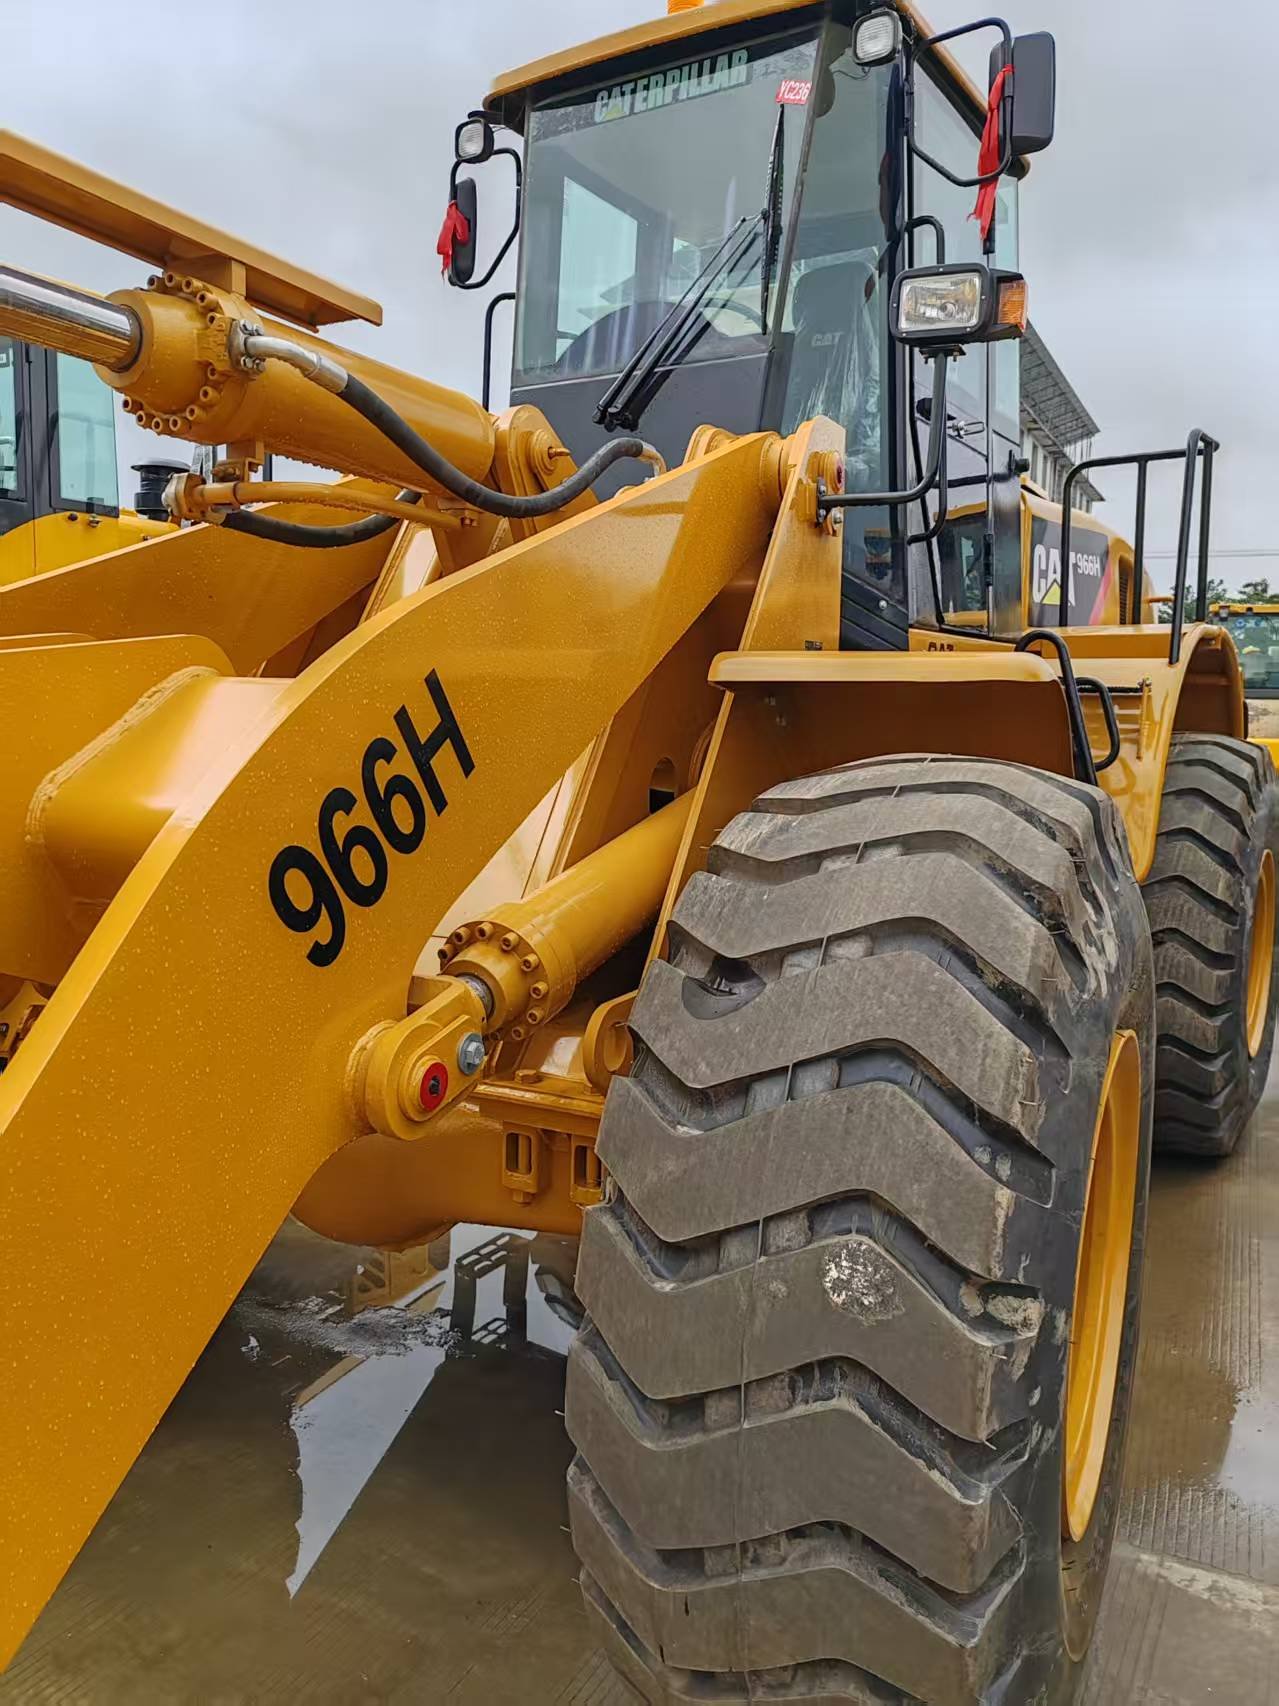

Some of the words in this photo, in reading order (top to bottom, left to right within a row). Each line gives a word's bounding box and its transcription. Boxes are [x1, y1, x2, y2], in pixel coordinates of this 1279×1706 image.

[595, 49, 749, 124] CATERPILLAR
[1076, 553, 1101, 578] 966H
[268, 668, 476, 968] 966H
